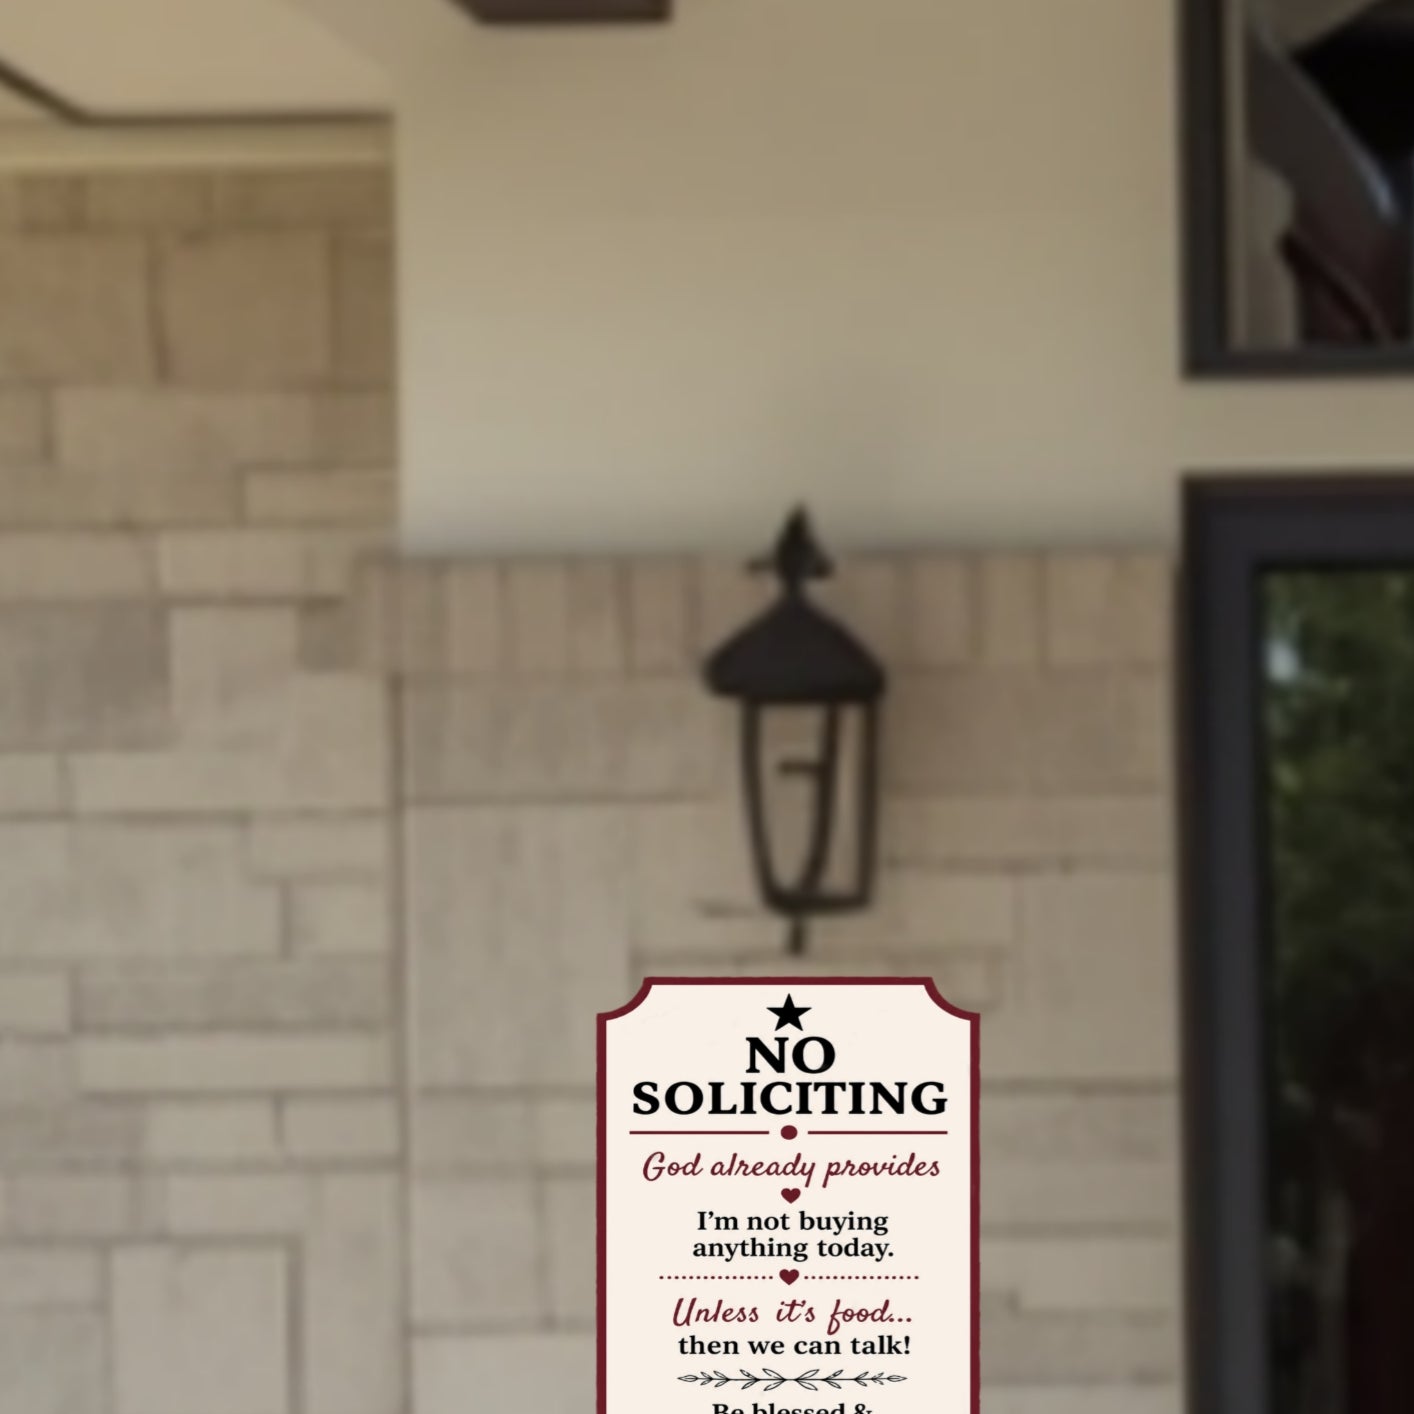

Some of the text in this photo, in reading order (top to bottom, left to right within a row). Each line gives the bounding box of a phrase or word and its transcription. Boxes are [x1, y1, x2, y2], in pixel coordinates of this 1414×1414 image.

[746, 1036, 835, 1074] NO
[632, 1081, 948, 1115] SOLICITING
[642, 1151, 940, 1188] God already provides
[697, 1211, 888, 1236] I’m not buying
[692, 1237, 894, 1262] anything today.
[672, 1298, 912, 1335] Unless it’s food...
[678, 1335, 911, 1355] then we can talk!
